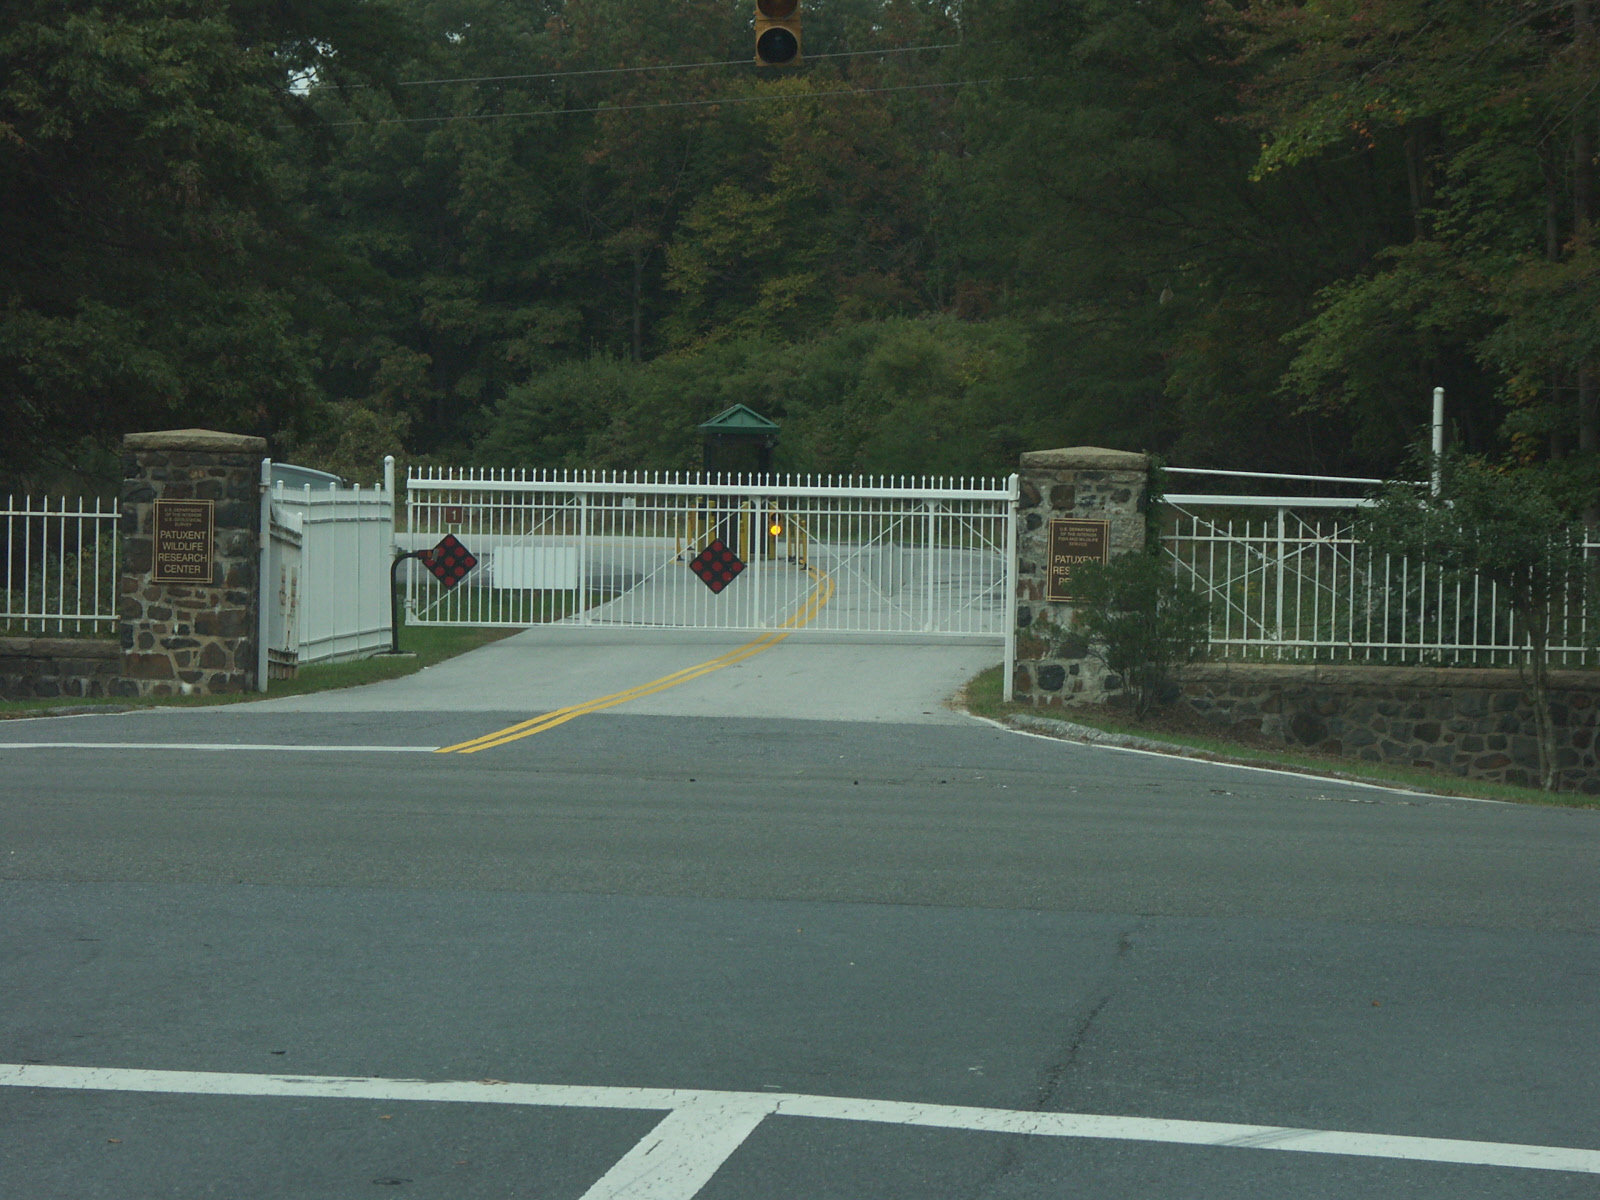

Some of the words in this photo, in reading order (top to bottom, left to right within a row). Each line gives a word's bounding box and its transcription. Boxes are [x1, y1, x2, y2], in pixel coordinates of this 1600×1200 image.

[452, 510, 456, 520] 1
[160, 530, 206, 540] PATUXENT
[162, 542, 204, 551] WILDLIFE
[158, 553, 208, 562] RESEARCH
[164, 564, 200, 574] CENTER
